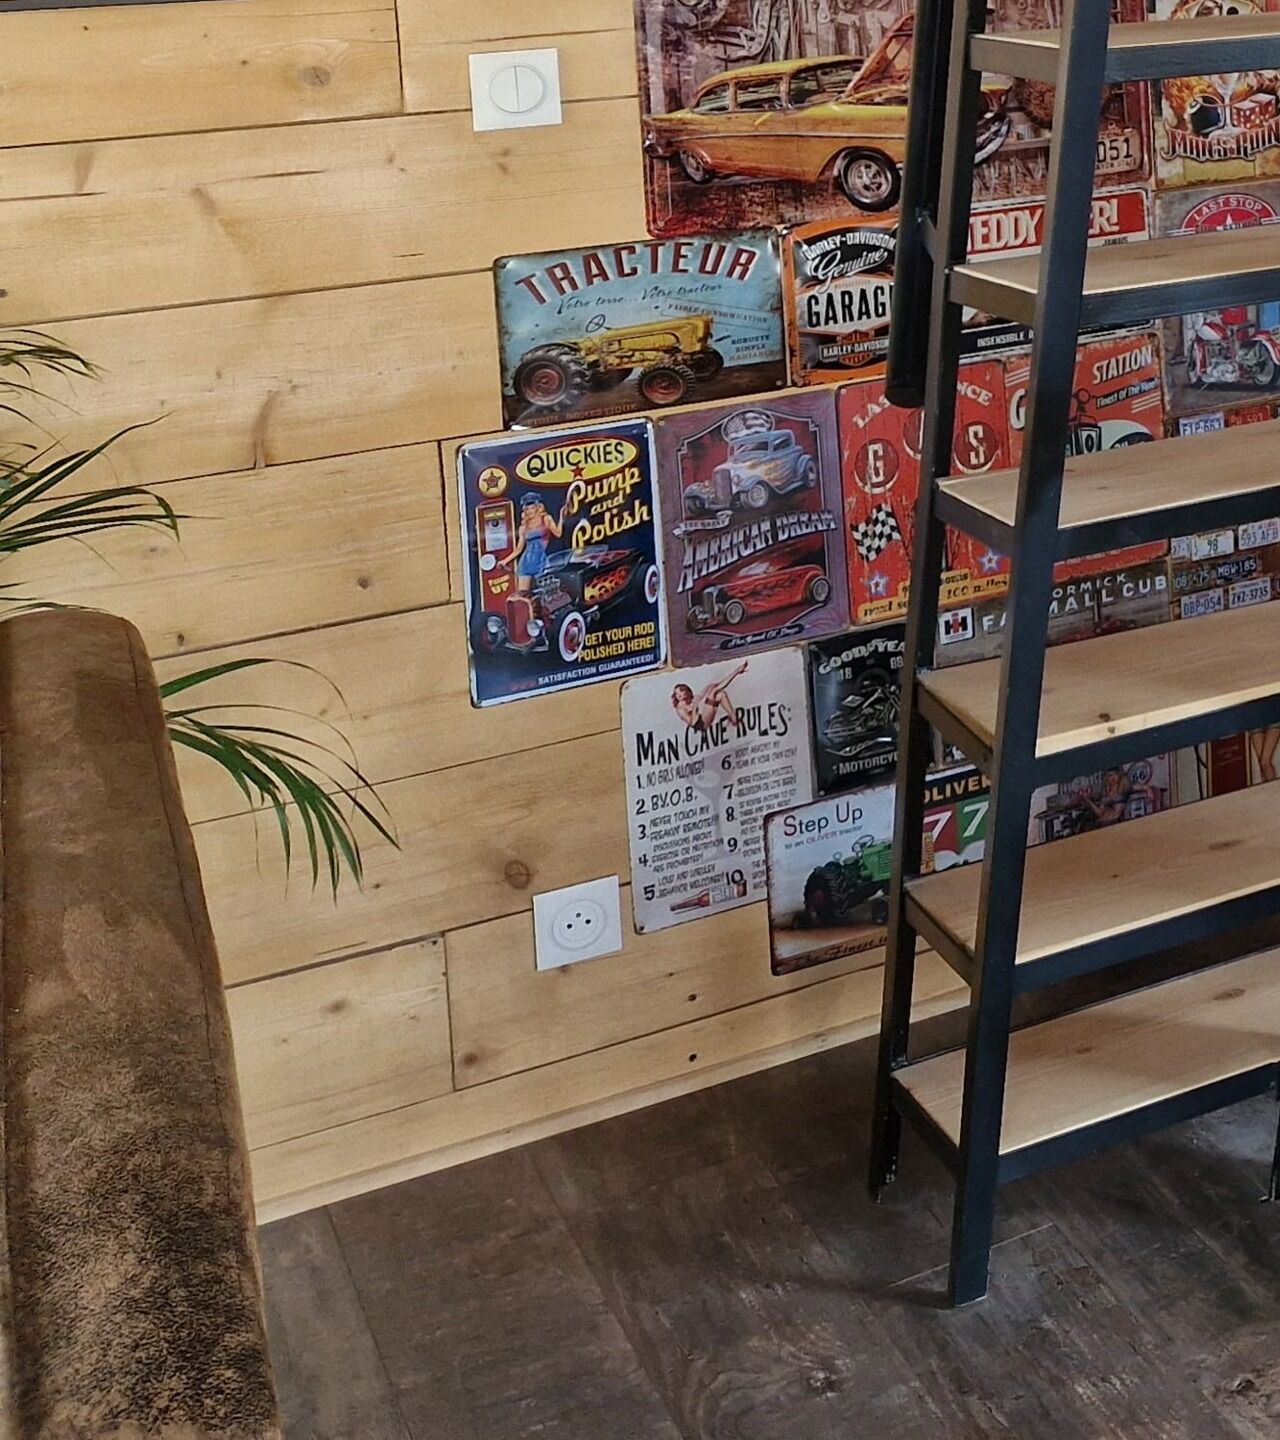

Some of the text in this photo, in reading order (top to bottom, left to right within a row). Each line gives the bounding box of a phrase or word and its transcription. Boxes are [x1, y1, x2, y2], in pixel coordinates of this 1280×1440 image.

[1194, 196, 1263, 221] LAST STOP
[800, 231, 897, 261] HARLEY-DAVIDSON
[513, 240, 759, 305] TRACTEUR
[809, 248, 888, 294] Genuine
[806, 284, 893, 328] GARAG
[730, 334, 771, 346] ROBUSTE
[735, 343, 768, 354] SIMPLE
[823, 340, 890, 357] HARLEY-DAVIDSON
[977, 333, 1024, 348] INSENSIBLE
[1092, 344, 1153, 385] STATION
[526, 441, 625, 478] QUICKIES
[968, 424, 984, 466] S
[868, 443, 885, 484] G
[567, 467, 642, 514] Pump
[590, 494, 625, 517] and
[572, 501, 652, 553] Polish
[677, 511, 839, 594] AMERICAN DREAM
[1216, 559, 1257, 578] MBW-185
[1122, 574, 1168, 598] CUB
[585, 622, 655, 646] GET YOUR ROD
[578, 636, 655, 663] POLISHED HERE!
[537, 654, 655, 686] SATISFACTION GUARANTEED!
[839, 667, 852, 681] 18
[783, 801, 863, 838] Step Up
[806, 831, 838, 846] OLIVER
